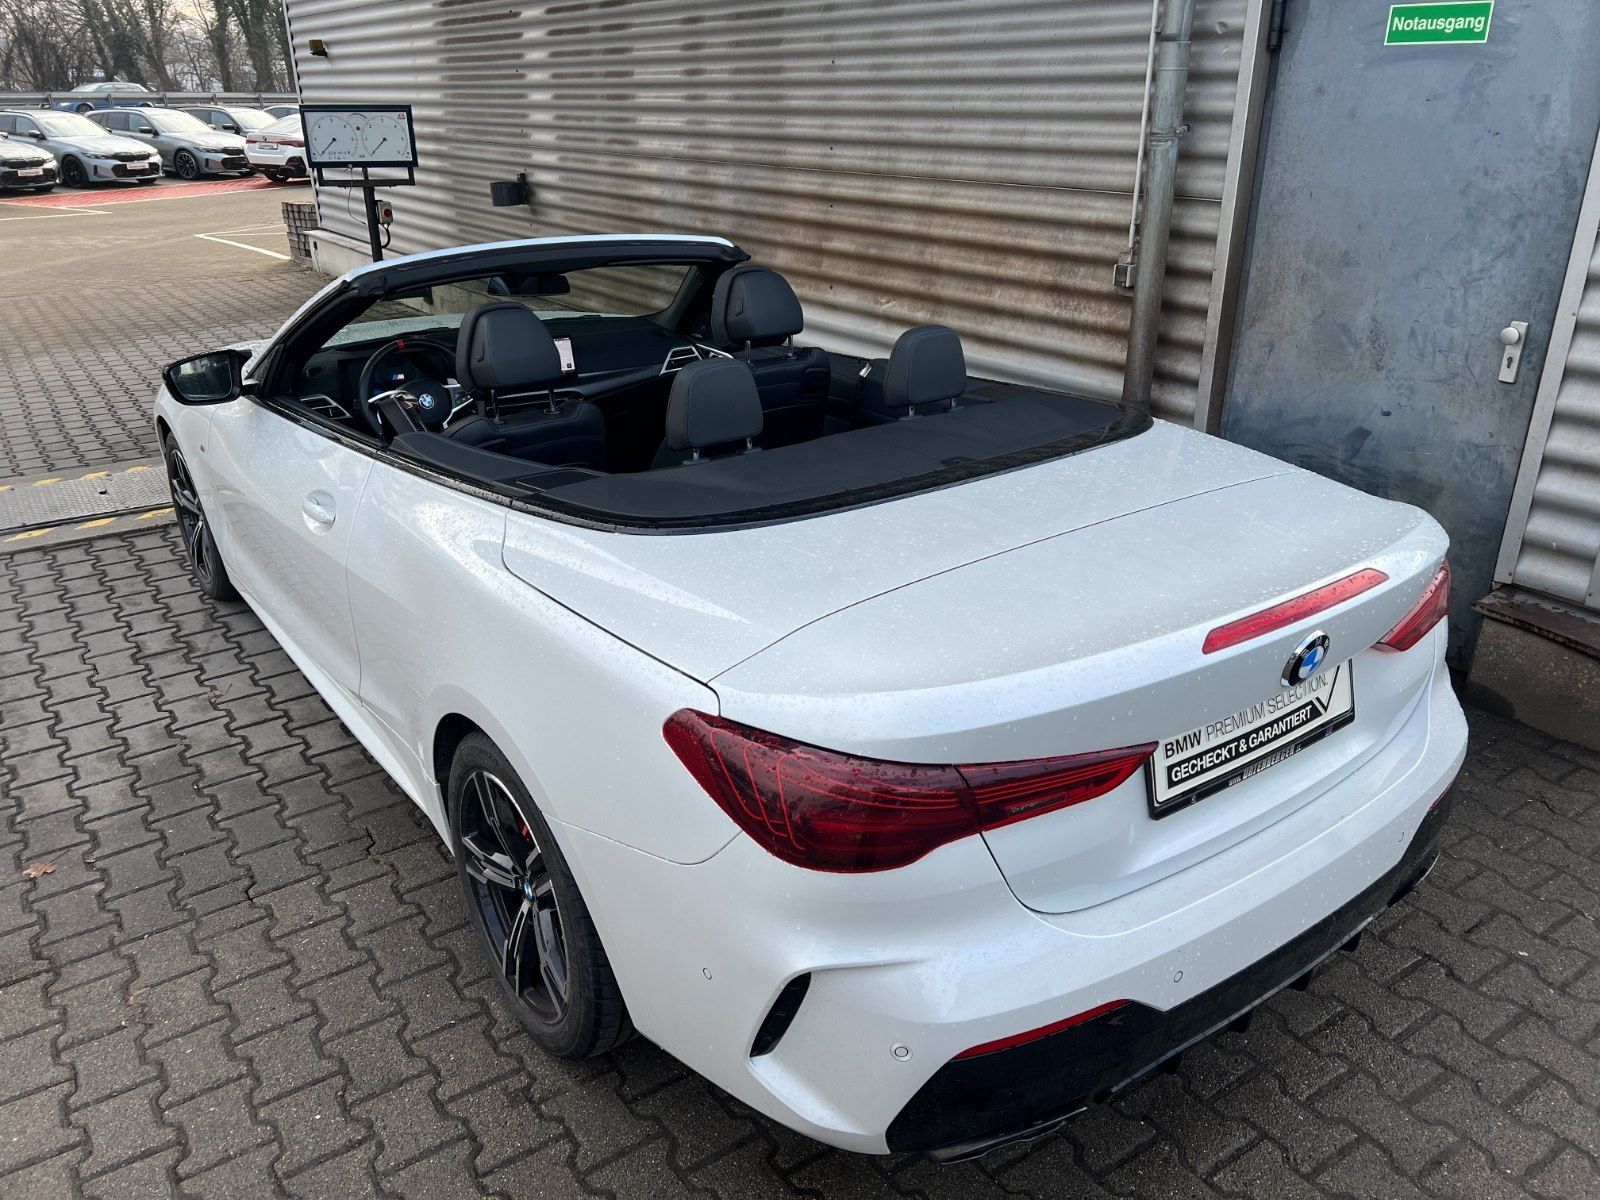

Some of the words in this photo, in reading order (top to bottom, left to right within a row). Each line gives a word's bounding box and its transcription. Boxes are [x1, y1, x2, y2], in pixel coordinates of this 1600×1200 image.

[1392, 16, 1486, 33] Notausgang
[1164, 729, 1202, 759] BMW
[1206, 702, 1266, 741] PREMIUM
[1171, 742, 1237, 782] GECHECKT
[1239, 739, 1248, 753] &
[1249, 705, 1312, 748] GARANTIERT
